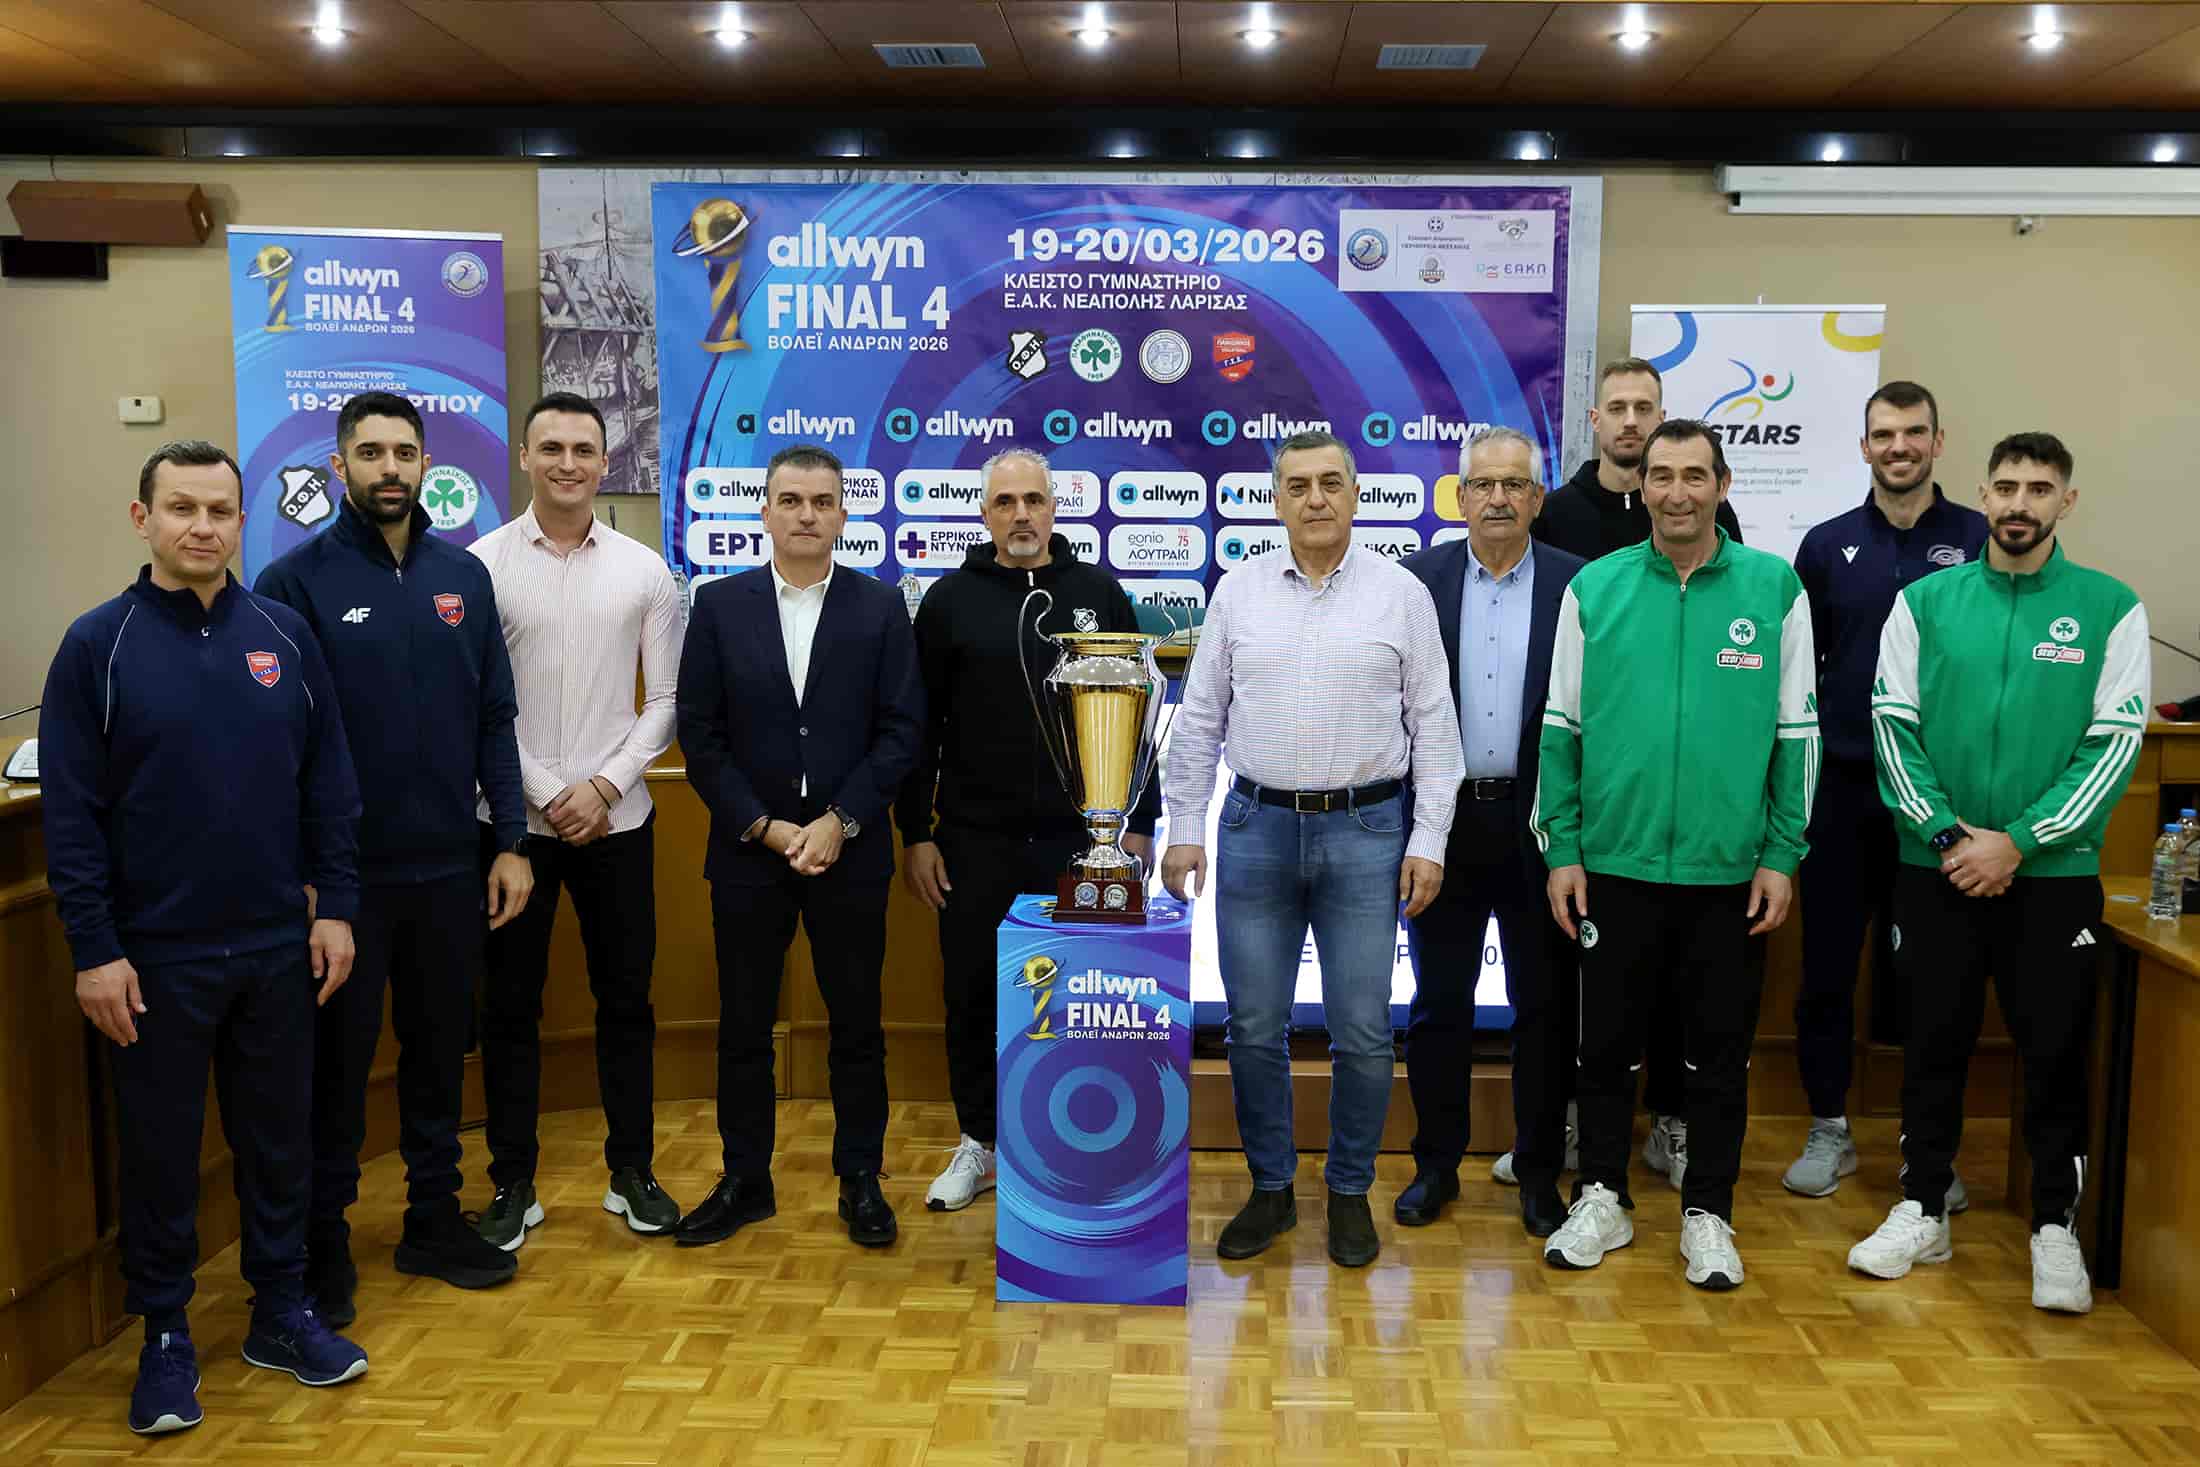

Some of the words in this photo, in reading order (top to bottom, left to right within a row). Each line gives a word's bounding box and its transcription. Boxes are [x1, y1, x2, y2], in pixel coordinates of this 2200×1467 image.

[767, 222, 925, 281] allwyn
[1007, 227, 1325, 265] 19-20/03/2026
[304, 259, 400, 294] allwyn
[1004, 273, 1082, 289] ΚΛΕΙΣΤΟ
[1088, 274, 1221, 290] ΓΥΜΝΑΣΤΗΡΙΟ
[305, 294, 390, 322] FINAL
[397, 297, 416, 322] 4
[767, 284, 906, 329] FINAL
[921, 286, 950, 330] 4
[1004, 294, 1057, 309] Ε.Α.Κ.
[1063, 294, 1165, 310] ΝΕΑΠΟΛΗΣ
[1170, 295, 1247, 310] ΛΑΡΙΣΑΣ
[768, 332, 823, 350] ΒΟΛΕΪ
[828, 336, 902, 351] ΑΝΔΡΩΝ
[908, 336, 949, 351] 2026
[768, 409, 856, 442] allwyn
[925, 411, 1014, 444] allwyn
[1084, 412, 1172, 445] allwyn
[1142, 485, 1199, 506] allwyn
[1360, 488, 1416, 508] allwyn
[708, 532, 764, 556] ΕΡΤ
[832, 536, 879, 556] llwyn
[930, 531, 983, 542] ΕΡΡΙΚΟΣ
[930, 541, 966, 552] ΝΤΥΝ
[1128, 548, 1189, 561] ΛΟΥΤΡΑΚΙ
[341, 607, 371, 623] 4F
[1067, 969, 1157, 1002] allwyn
[1067, 1002, 1146, 1028] FINAL
[1155, 1005, 1171, 1028] 4
[1102, 1031, 1144, 1041] ΑΝΔΡΩΝ
[1147, 1031, 1170, 1041] 2026
